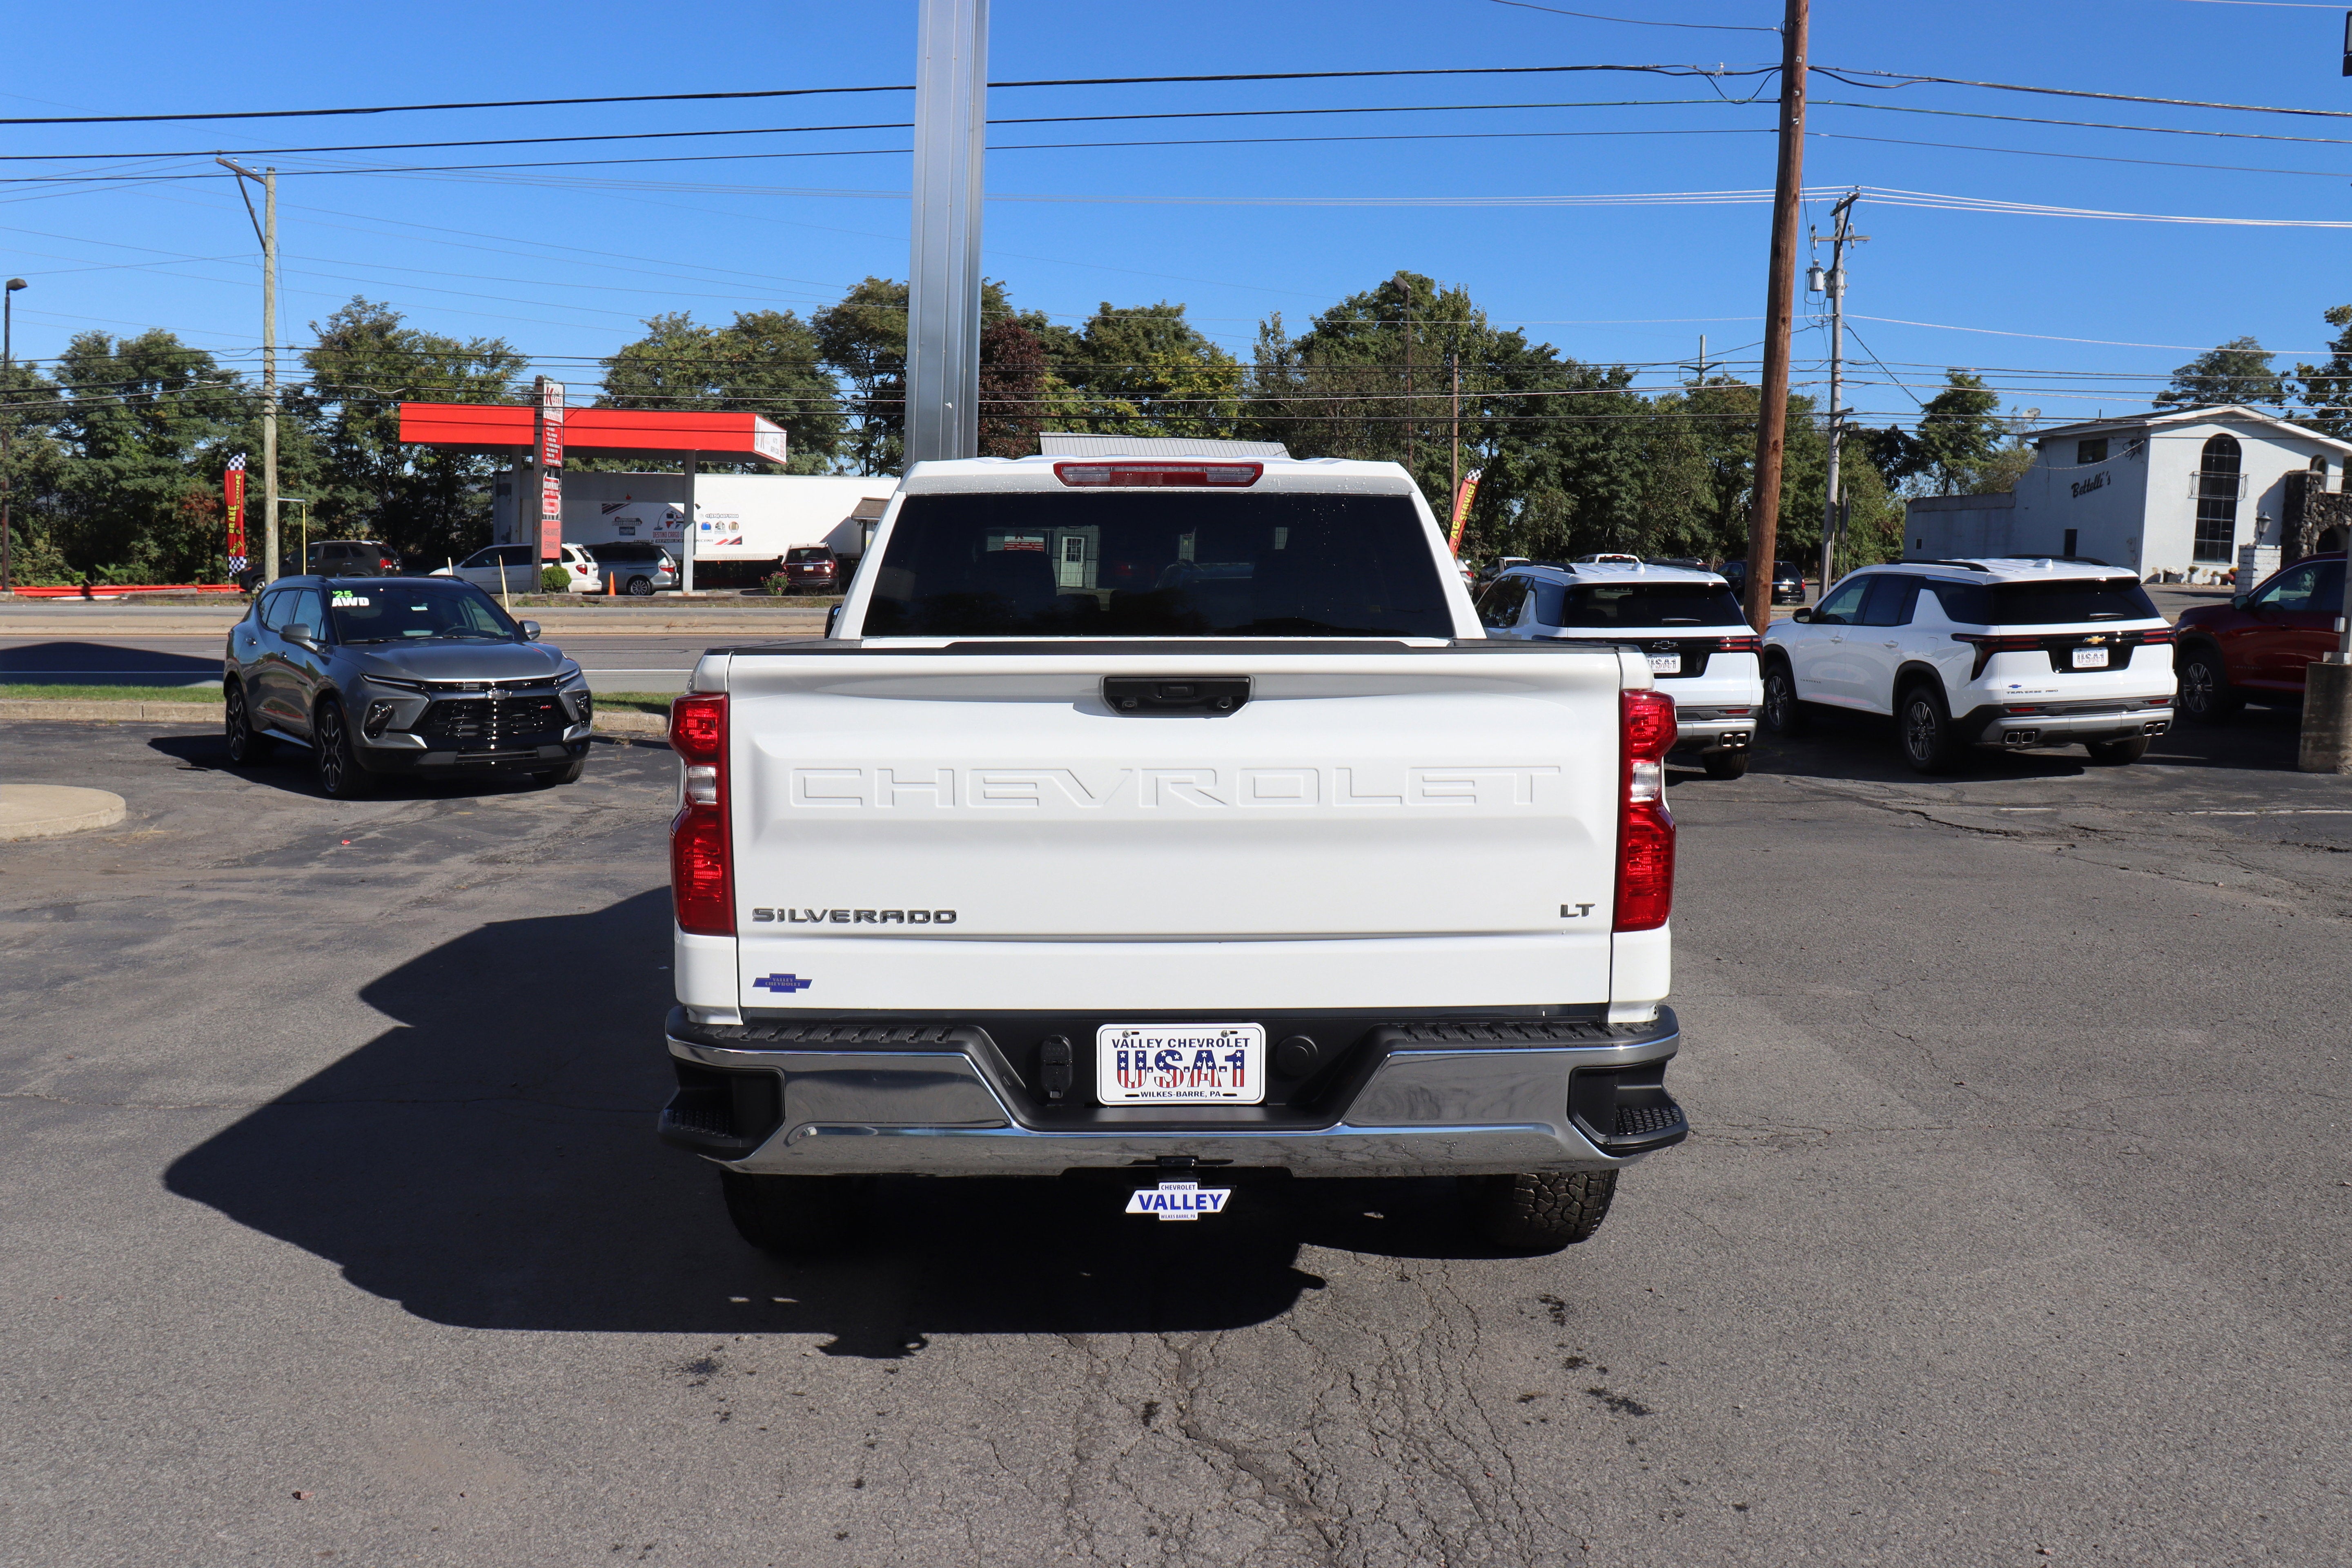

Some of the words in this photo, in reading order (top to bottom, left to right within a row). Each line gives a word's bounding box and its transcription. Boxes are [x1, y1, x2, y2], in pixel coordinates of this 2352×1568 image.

[2071, 471, 2111, 498] Bettelli's
[1459, 483, 1477, 521] SERVICE
[228, 505, 237, 533] BRAKE
[1450, 521, 1461, 539] AC
[332, 597, 369, 607] AWD
[790, 766, 1561, 808] CHEVROLET
[752, 908, 957, 924] SILVERADO
[1560, 903, 1595, 918] LT
[1111, 1038, 1163, 1048] VALLEY
[1167, 1038, 1250, 1048] CHEVROLET
[1138, 1194, 1223, 1210] VALLEY
